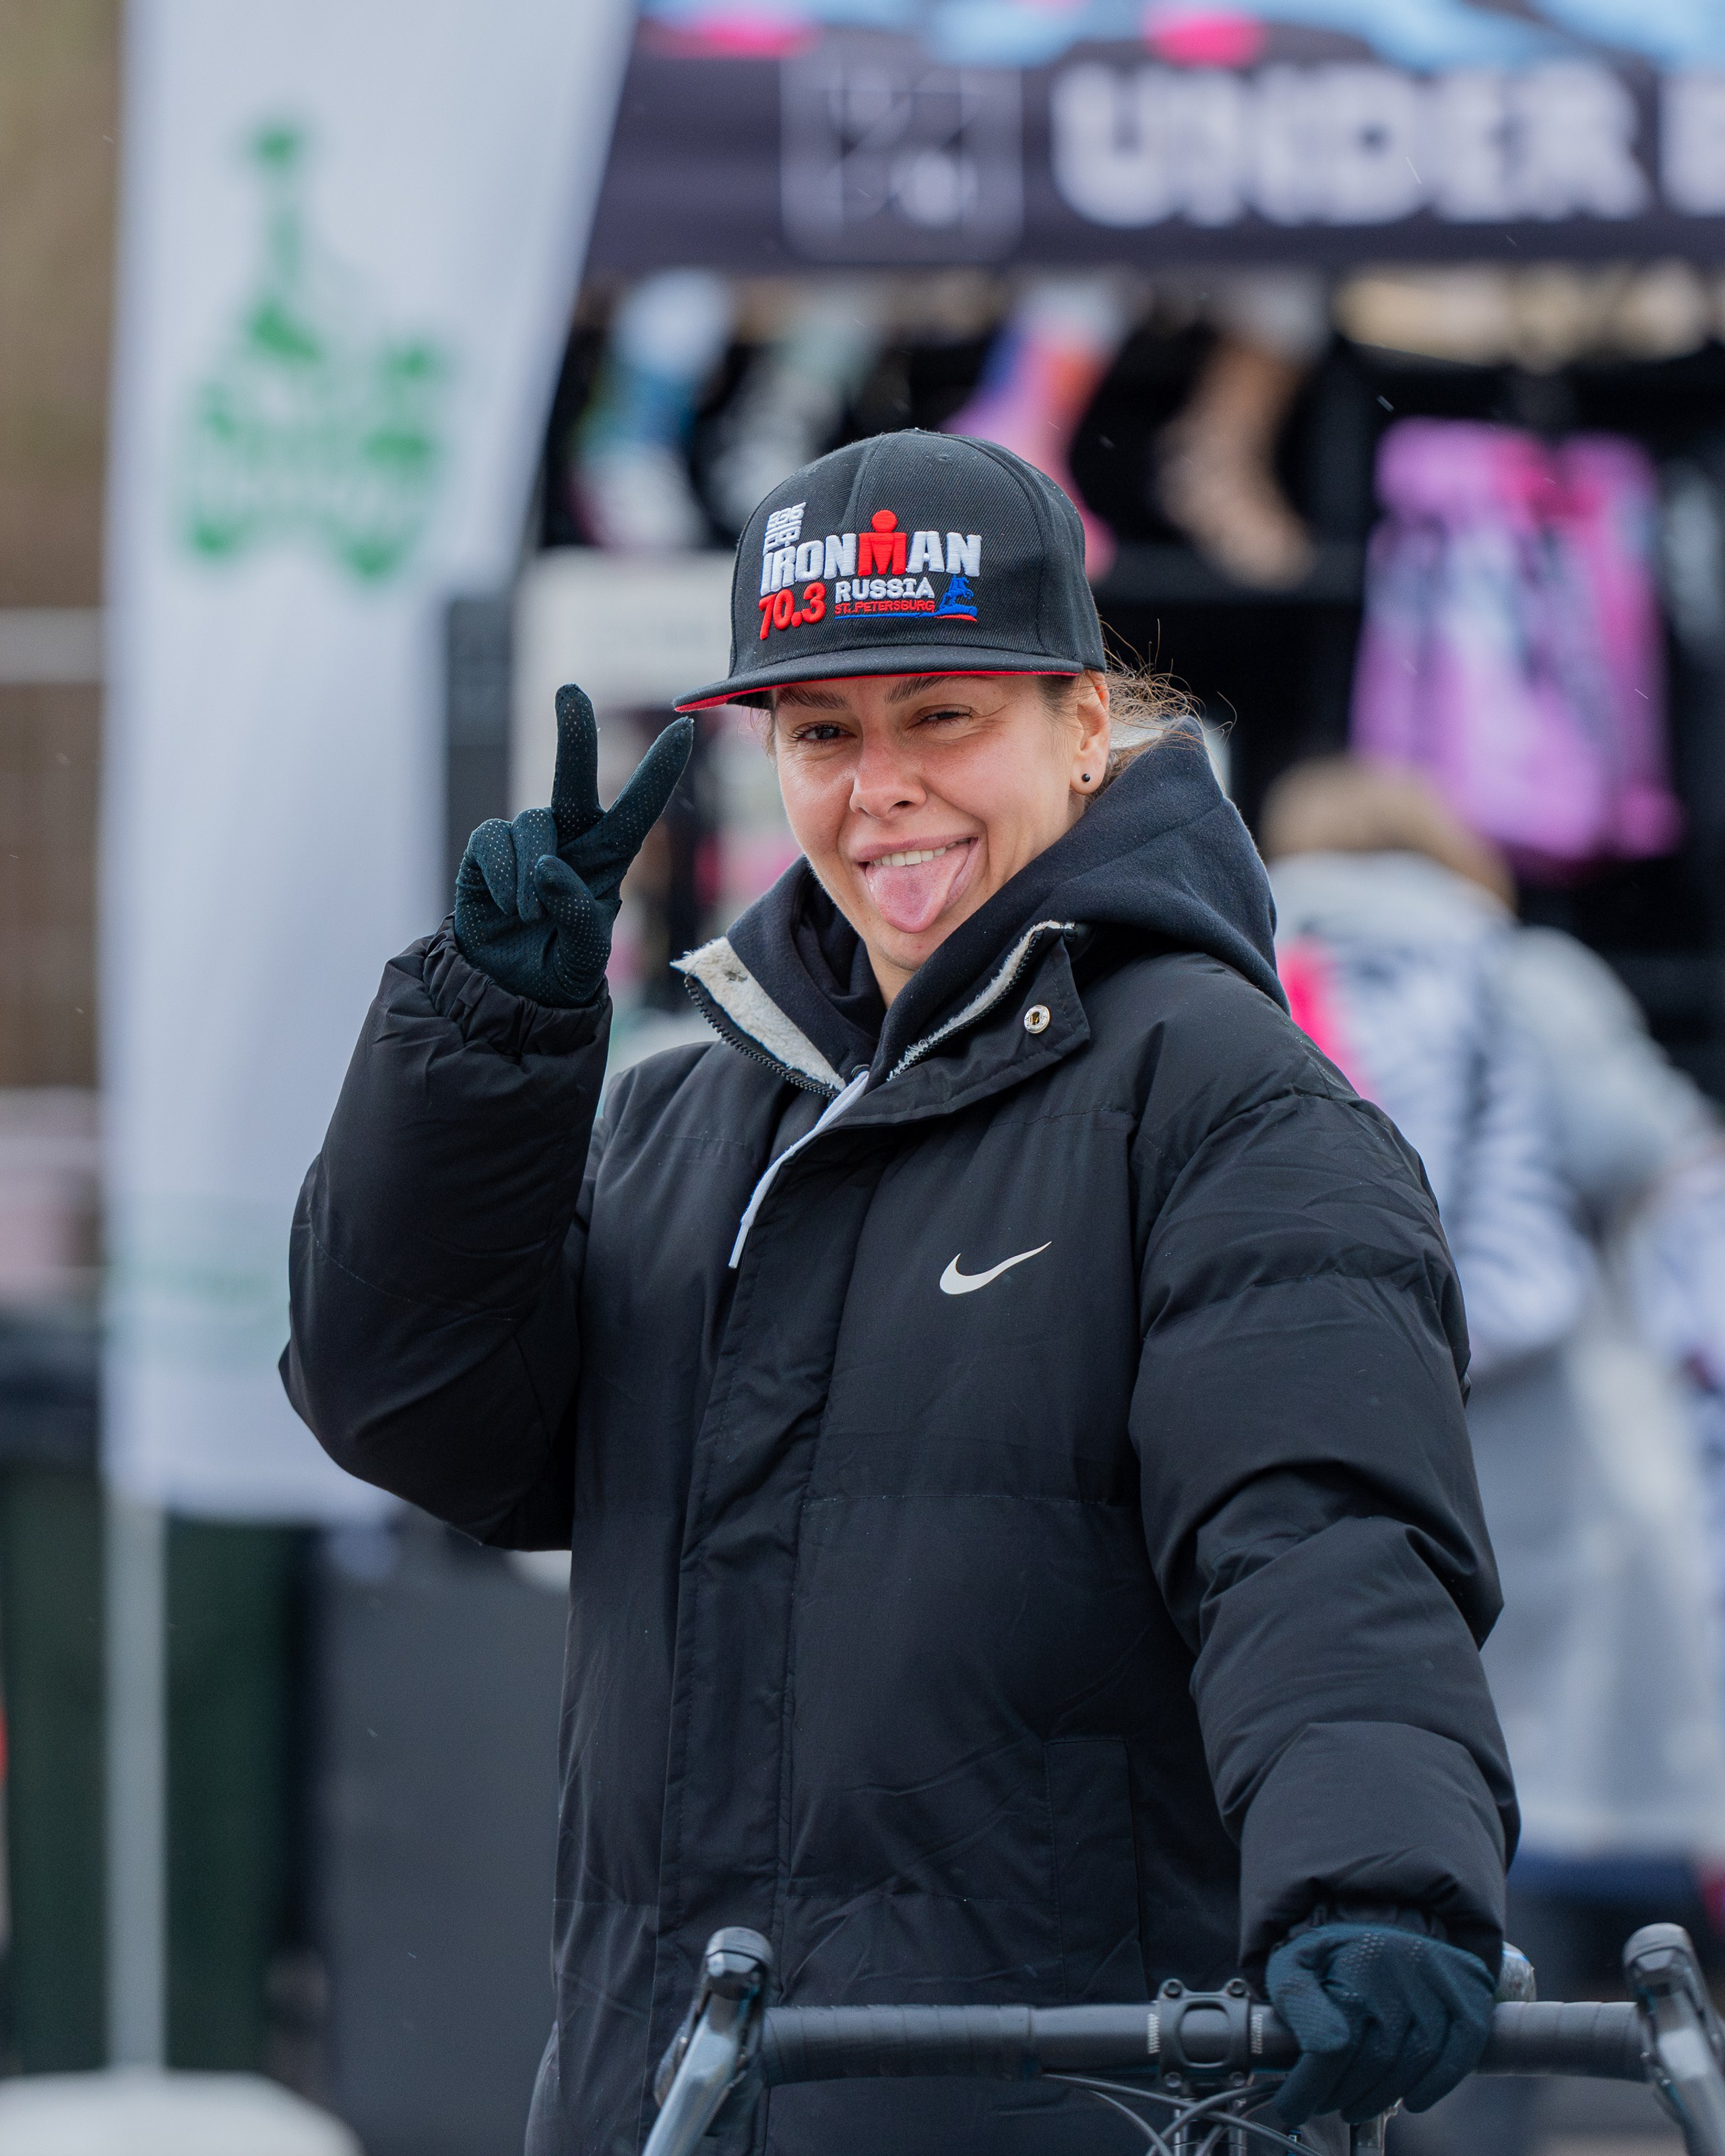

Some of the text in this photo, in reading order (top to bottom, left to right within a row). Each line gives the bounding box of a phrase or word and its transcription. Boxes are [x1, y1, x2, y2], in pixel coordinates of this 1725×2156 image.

[760, 510, 982, 597] IRONMAN
[758, 582, 827, 640] 70.3
[835, 576, 935, 604] RUSSIA
